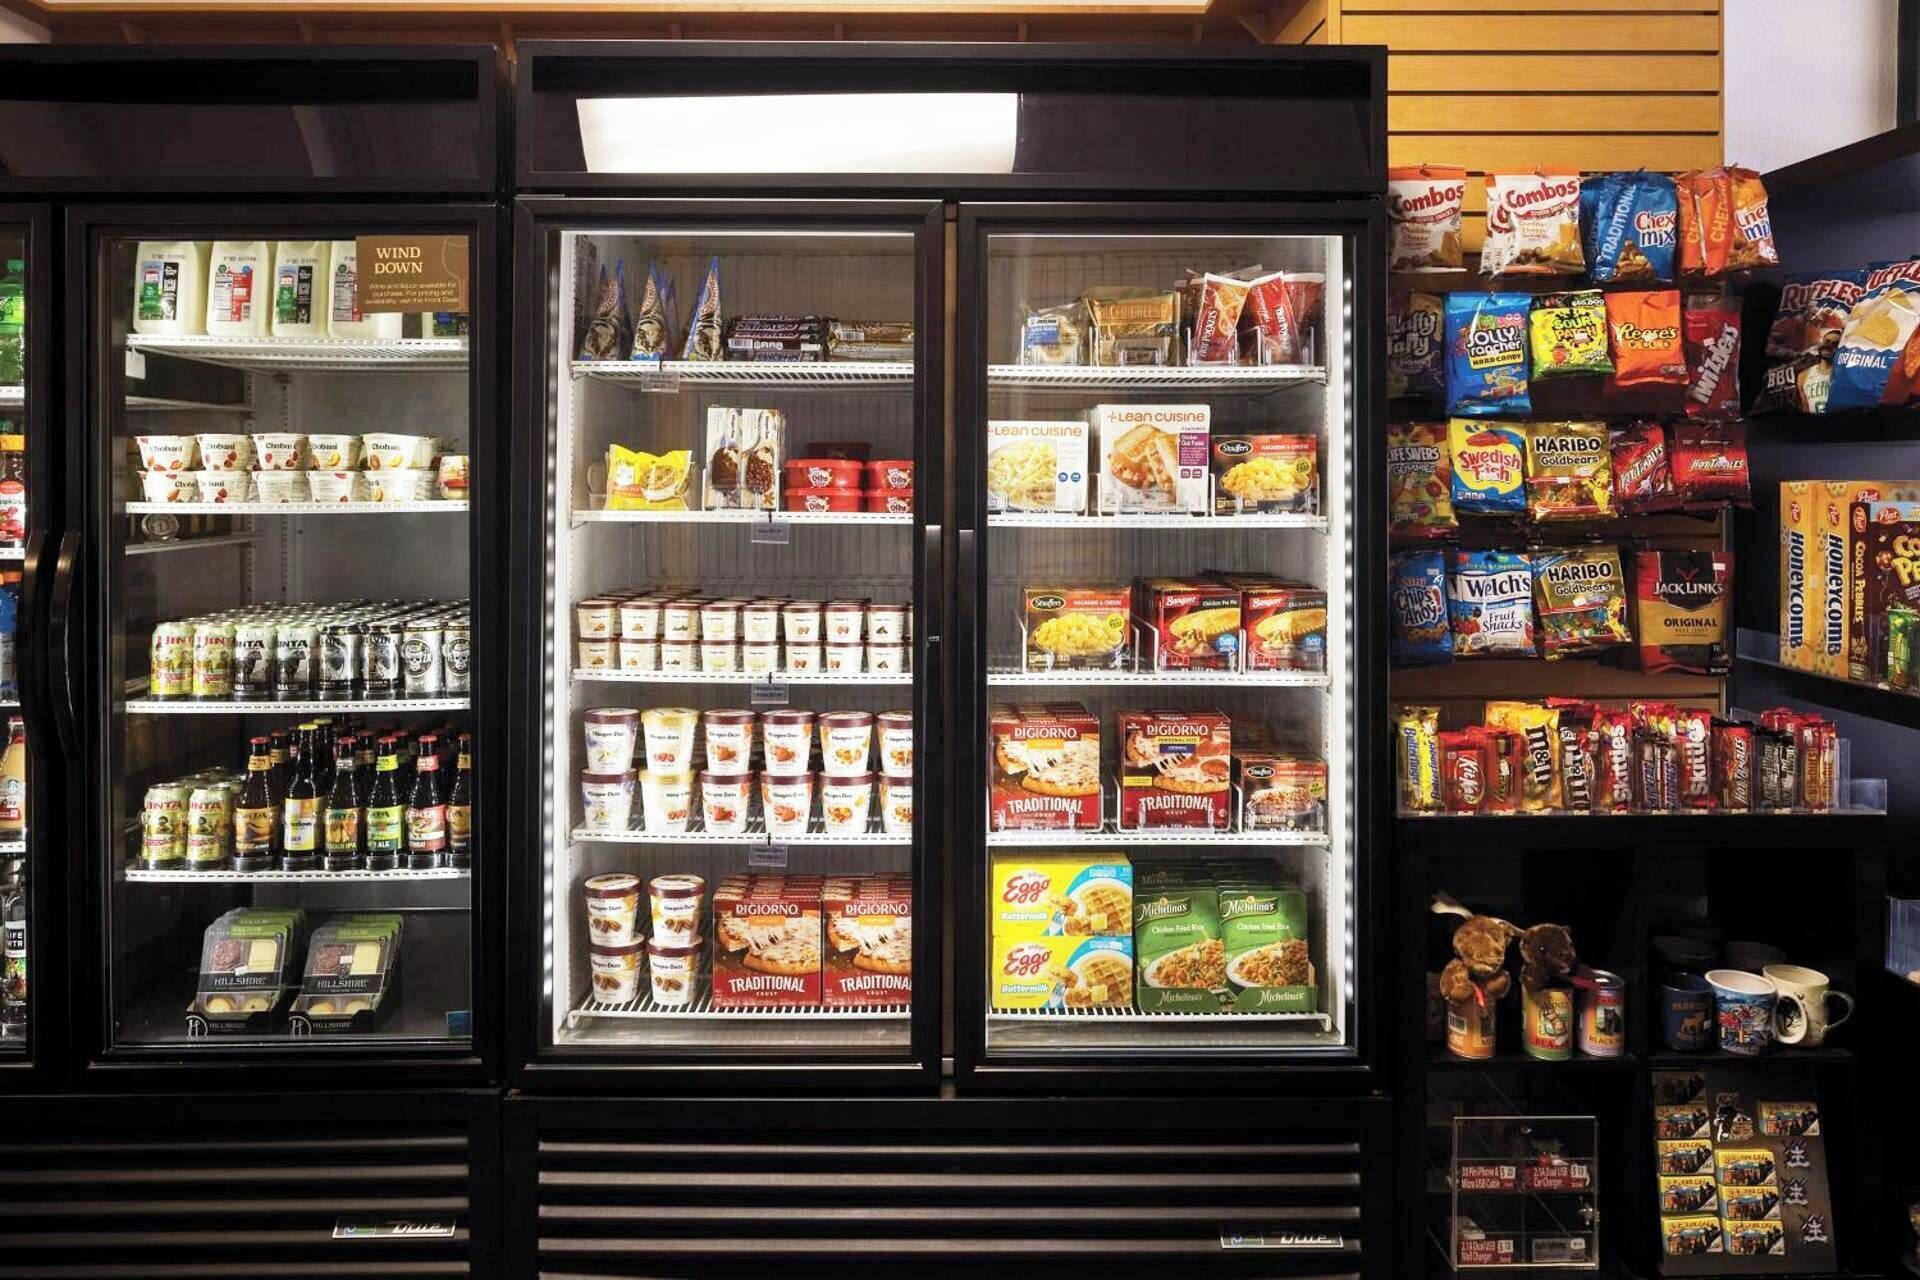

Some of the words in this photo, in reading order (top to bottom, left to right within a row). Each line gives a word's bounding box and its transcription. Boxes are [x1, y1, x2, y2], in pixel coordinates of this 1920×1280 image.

[1389, 185, 1464, 217] Combos
[1505, 179, 1578, 209] Combos
[1635, 211, 1677, 230] Chex
[1641, 227, 1676, 246] mix
[376, 247, 421, 259] WIND
[374, 261, 423, 274] DOWN
[1779, 280, 1864, 312] RUFFLES
[1553, 316, 1592, 331] SOUR
[1618, 323, 1679, 341] Reese's
[1466, 327, 1517, 348] JOLLY
[1554, 326, 1598, 341] PATCH
[1471, 340, 1521, 357] rancher
[1473, 358, 1496, 367] HARD
[1838, 352, 1888, 369] ORIGINAL
[1768, 366, 1796, 388] BBQ
[1118, 411, 1153, 422] Lean
[1154, 411, 1206, 422] cuisine
[994, 426, 1030, 437] Lean
[1031, 426, 1082, 437] cuisine
[1407, 446, 1440, 460] SAVERS
[1535, 437, 1601, 453] HARIBO
[1458, 450, 1521, 470] Swedish
[1540, 455, 1598, 466] Goldbears
[1471, 466, 1511, 483] Fish
[1857, 491, 1879, 503] Post
[1855, 541, 1866, 577] COCOA
[1547, 562, 1613, 583] HARIBO
[1465, 574, 1531, 598] Welch's
[1555, 583, 1611, 596] Goldbears
[1653, 582, 1684, 595] JACK
[1396, 587, 1432, 610] Chips
[1855, 578, 1866, 624] PEBBLES
[1489, 611, 1515, 623] Fruit
[1664, 618, 1718, 627] ORIGINAL
[1483, 620, 1523, 634] Snacks
[1014, 727, 1078, 739] DIGIORNO
[1147, 725, 1209, 737] DIGIORNO
[1611, 724, 1632, 802] Skittles
[1690, 718, 1708, 796] Skittles
[1007, 798, 1084, 815] TRADITIONAL
[1138, 795, 1215, 812] TRADITIONAL
[1003, 875, 1052, 904] Eggo
[735, 904, 799, 915] DIGIORNO
[845, 904, 909, 915] DIGIORNO
[1001, 912, 1048, 921] Buttermilk
[1136, 903, 1188, 922] Michelina's
[1222, 900, 1276, 918] Michelina's
[1152, 926, 1175, 934] Chicken
[1237, 923, 1261, 931] Chicken
[1003, 948, 1053, 976] Eggo
[214, 976, 266, 986] HILLSHIRE
[316, 979, 369, 988] HILLSHIRE
[728, 976, 806, 993] TRADITIONAL
[1001, 984, 1049, 993] Buttermilk
[1158, 990, 1204, 1007] Michelina's
[1257, 990, 1305, 1007] Michelina's
